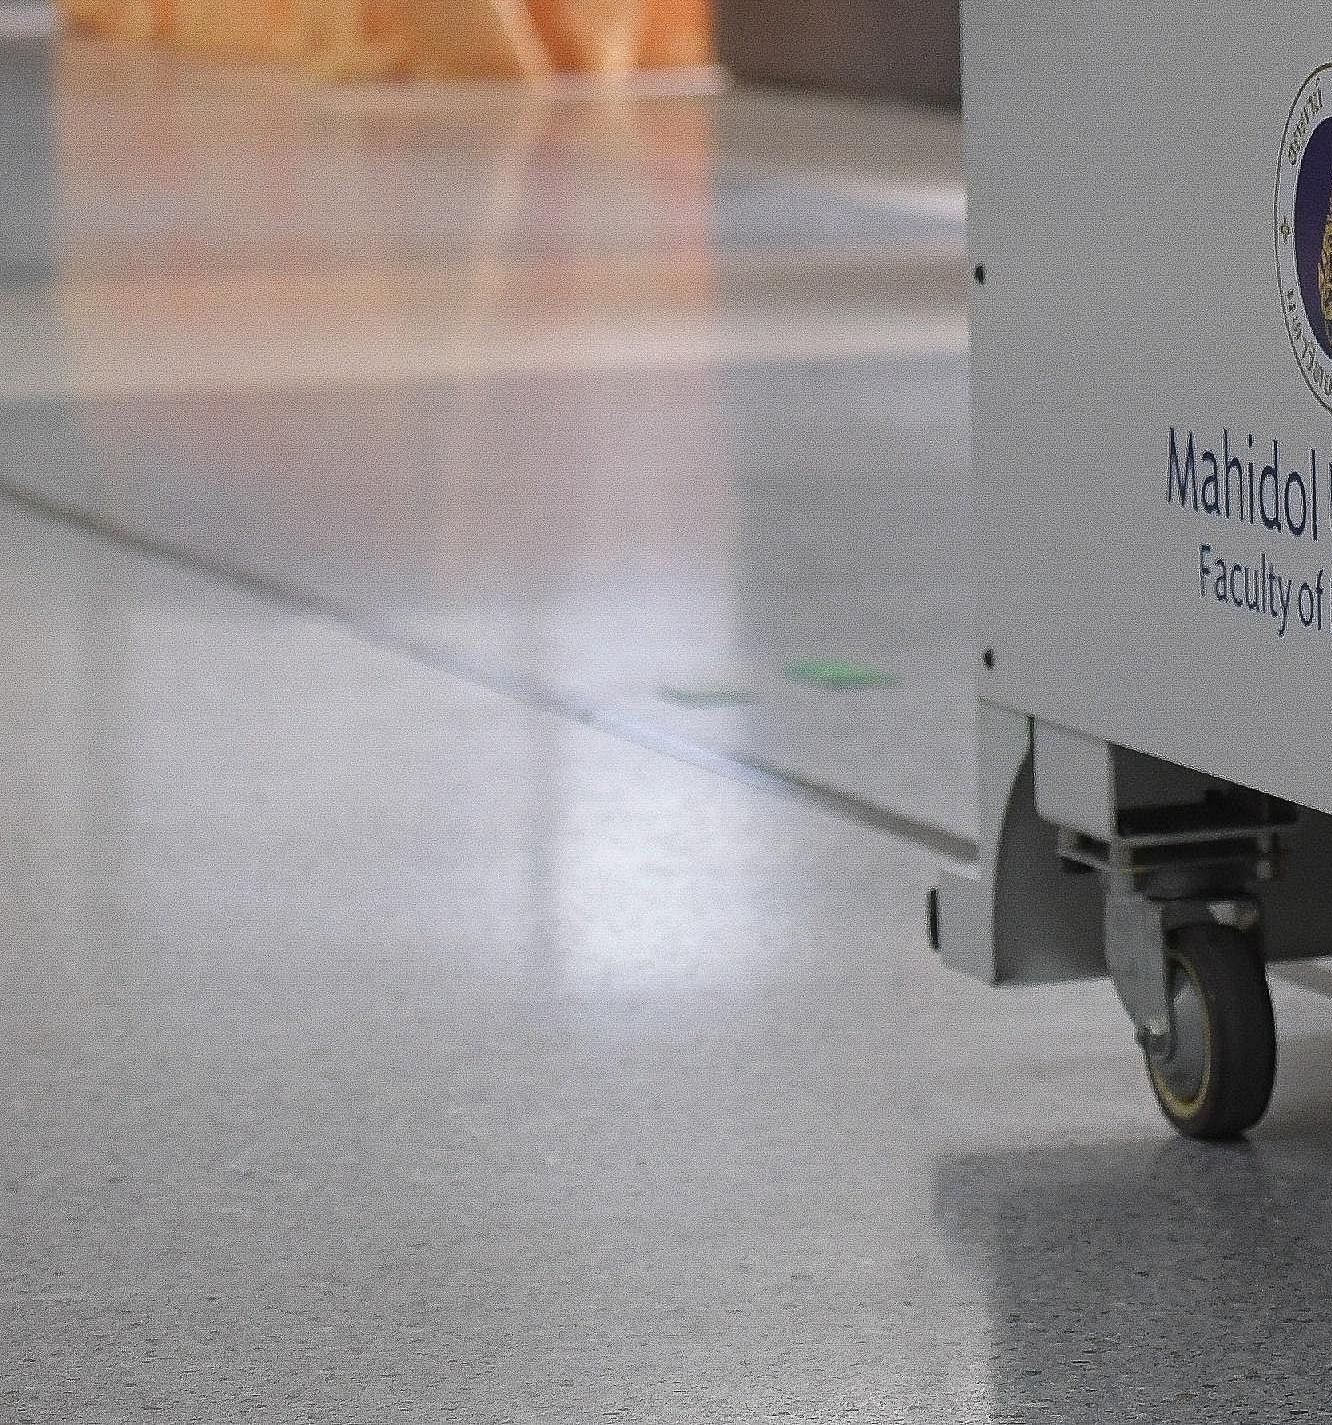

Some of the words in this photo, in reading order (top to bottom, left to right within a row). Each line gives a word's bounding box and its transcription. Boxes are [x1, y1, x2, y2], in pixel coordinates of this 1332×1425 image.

[1166, 426, 1319, 543] Mahidol
[1199, 542, 1292, 638] Faculty
[1298, 568, 1326, 632] of
